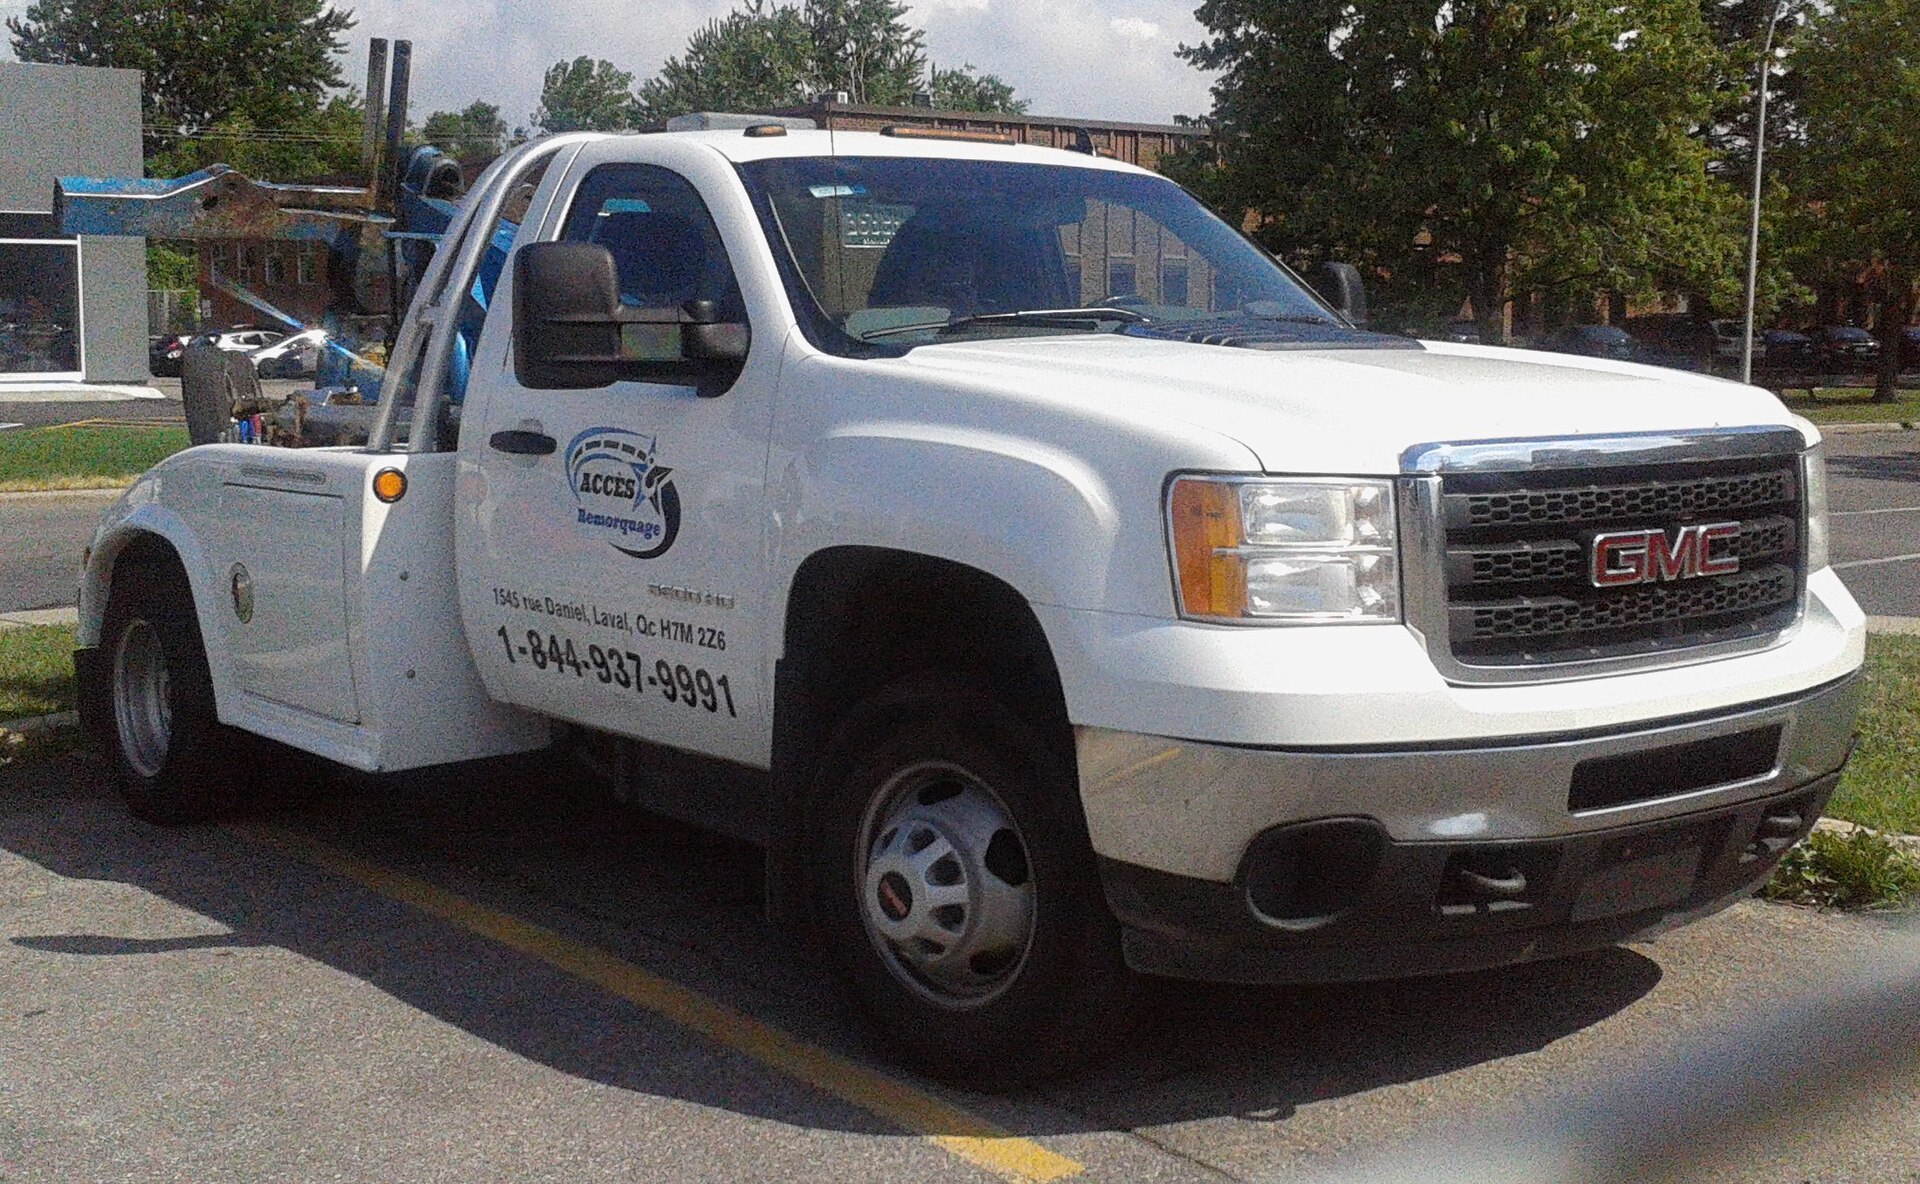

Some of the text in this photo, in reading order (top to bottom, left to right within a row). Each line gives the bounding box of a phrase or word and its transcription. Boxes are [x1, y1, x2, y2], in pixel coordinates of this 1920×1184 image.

[577, 507, 662, 540] Remorquage
[1592, 521, 1741, 587] GMC
[492, 587, 727, 652] 1545 rue Daniel, Laval, Qc H7M 2Z6
[497, 624, 738, 719] 1-844-937-9991
